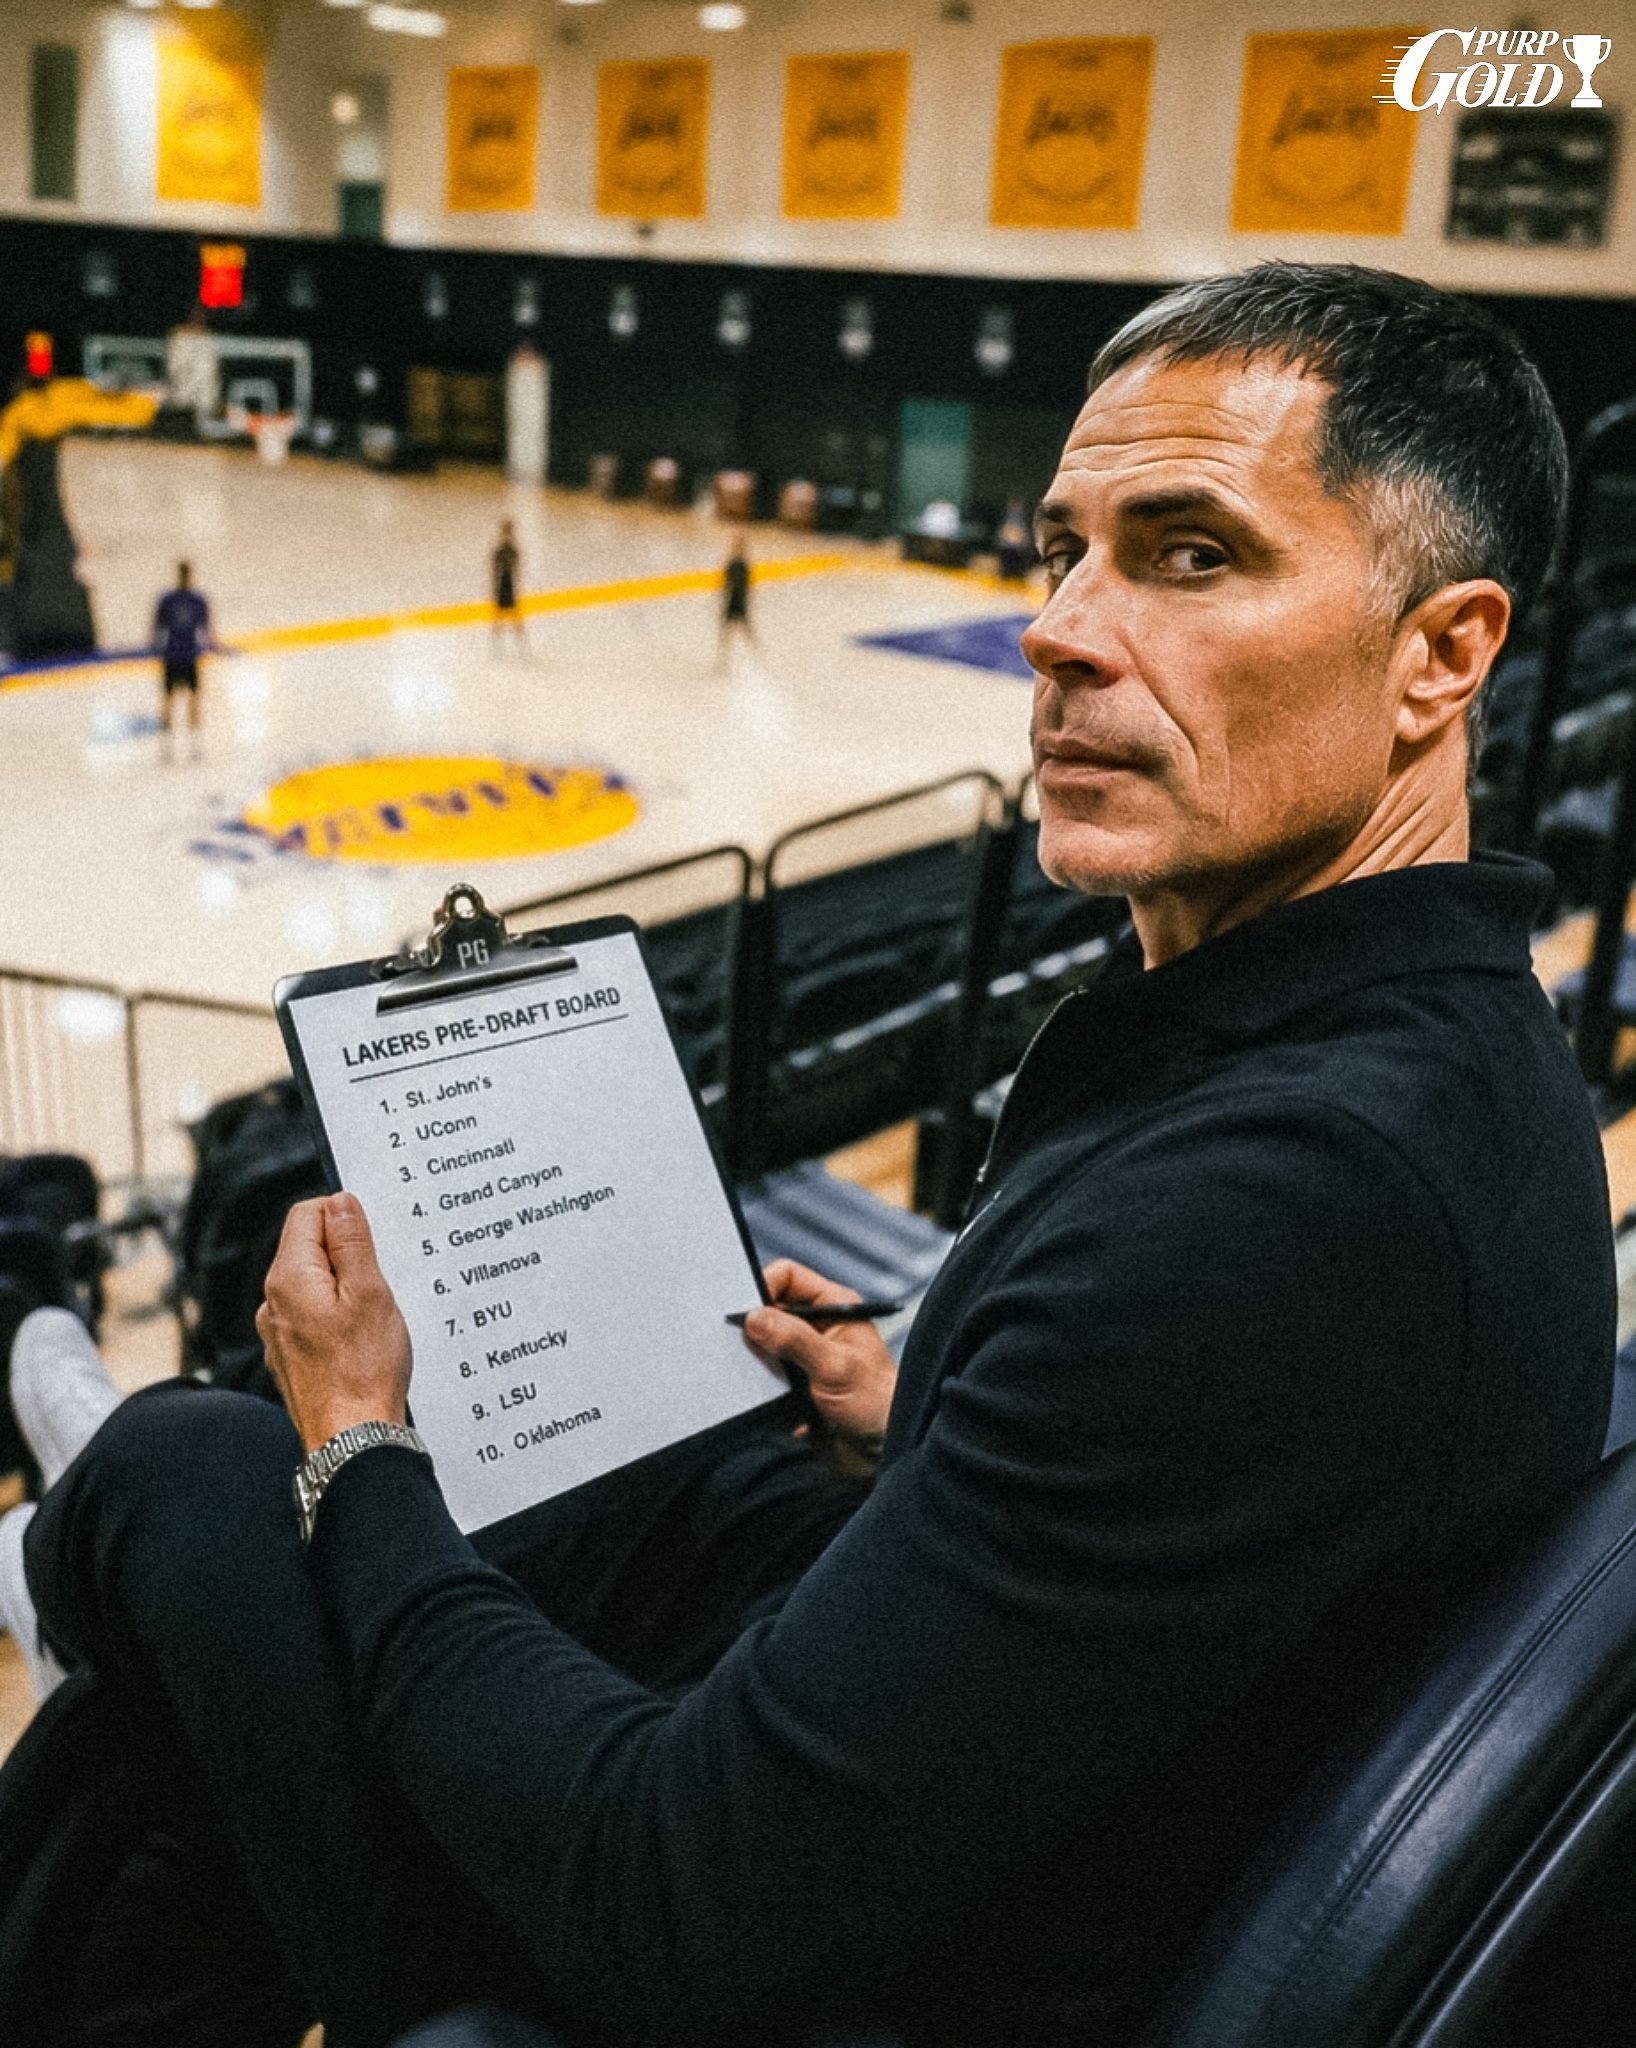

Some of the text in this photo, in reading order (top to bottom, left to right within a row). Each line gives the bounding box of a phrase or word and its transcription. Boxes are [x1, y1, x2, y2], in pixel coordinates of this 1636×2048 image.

[457, 938, 490, 970] PG
[341, 986, 622, 1068] LAKERS PRE-DRAFT BOARD
[379, 1076, 493, 1115] 1. St. John's
[389, 1115, 478, 1149] 2. UConn
[399, 1166, 418, 1183] 3.
[411, 1164, 563, 1219] 4. Grand Canyon
[421, 1185, 616, 1256] 5. George Washington
[433, 1250, 543, 1295] 6. Villanova
[444, 1300, 514, 1337] 7. BYU
[458, 1329, 568, 1379] 8. Kentucky
[471, 1382, 538, 1421] 9. LSU
[475, 1406, 603, 1465] 10. Oklahoma
